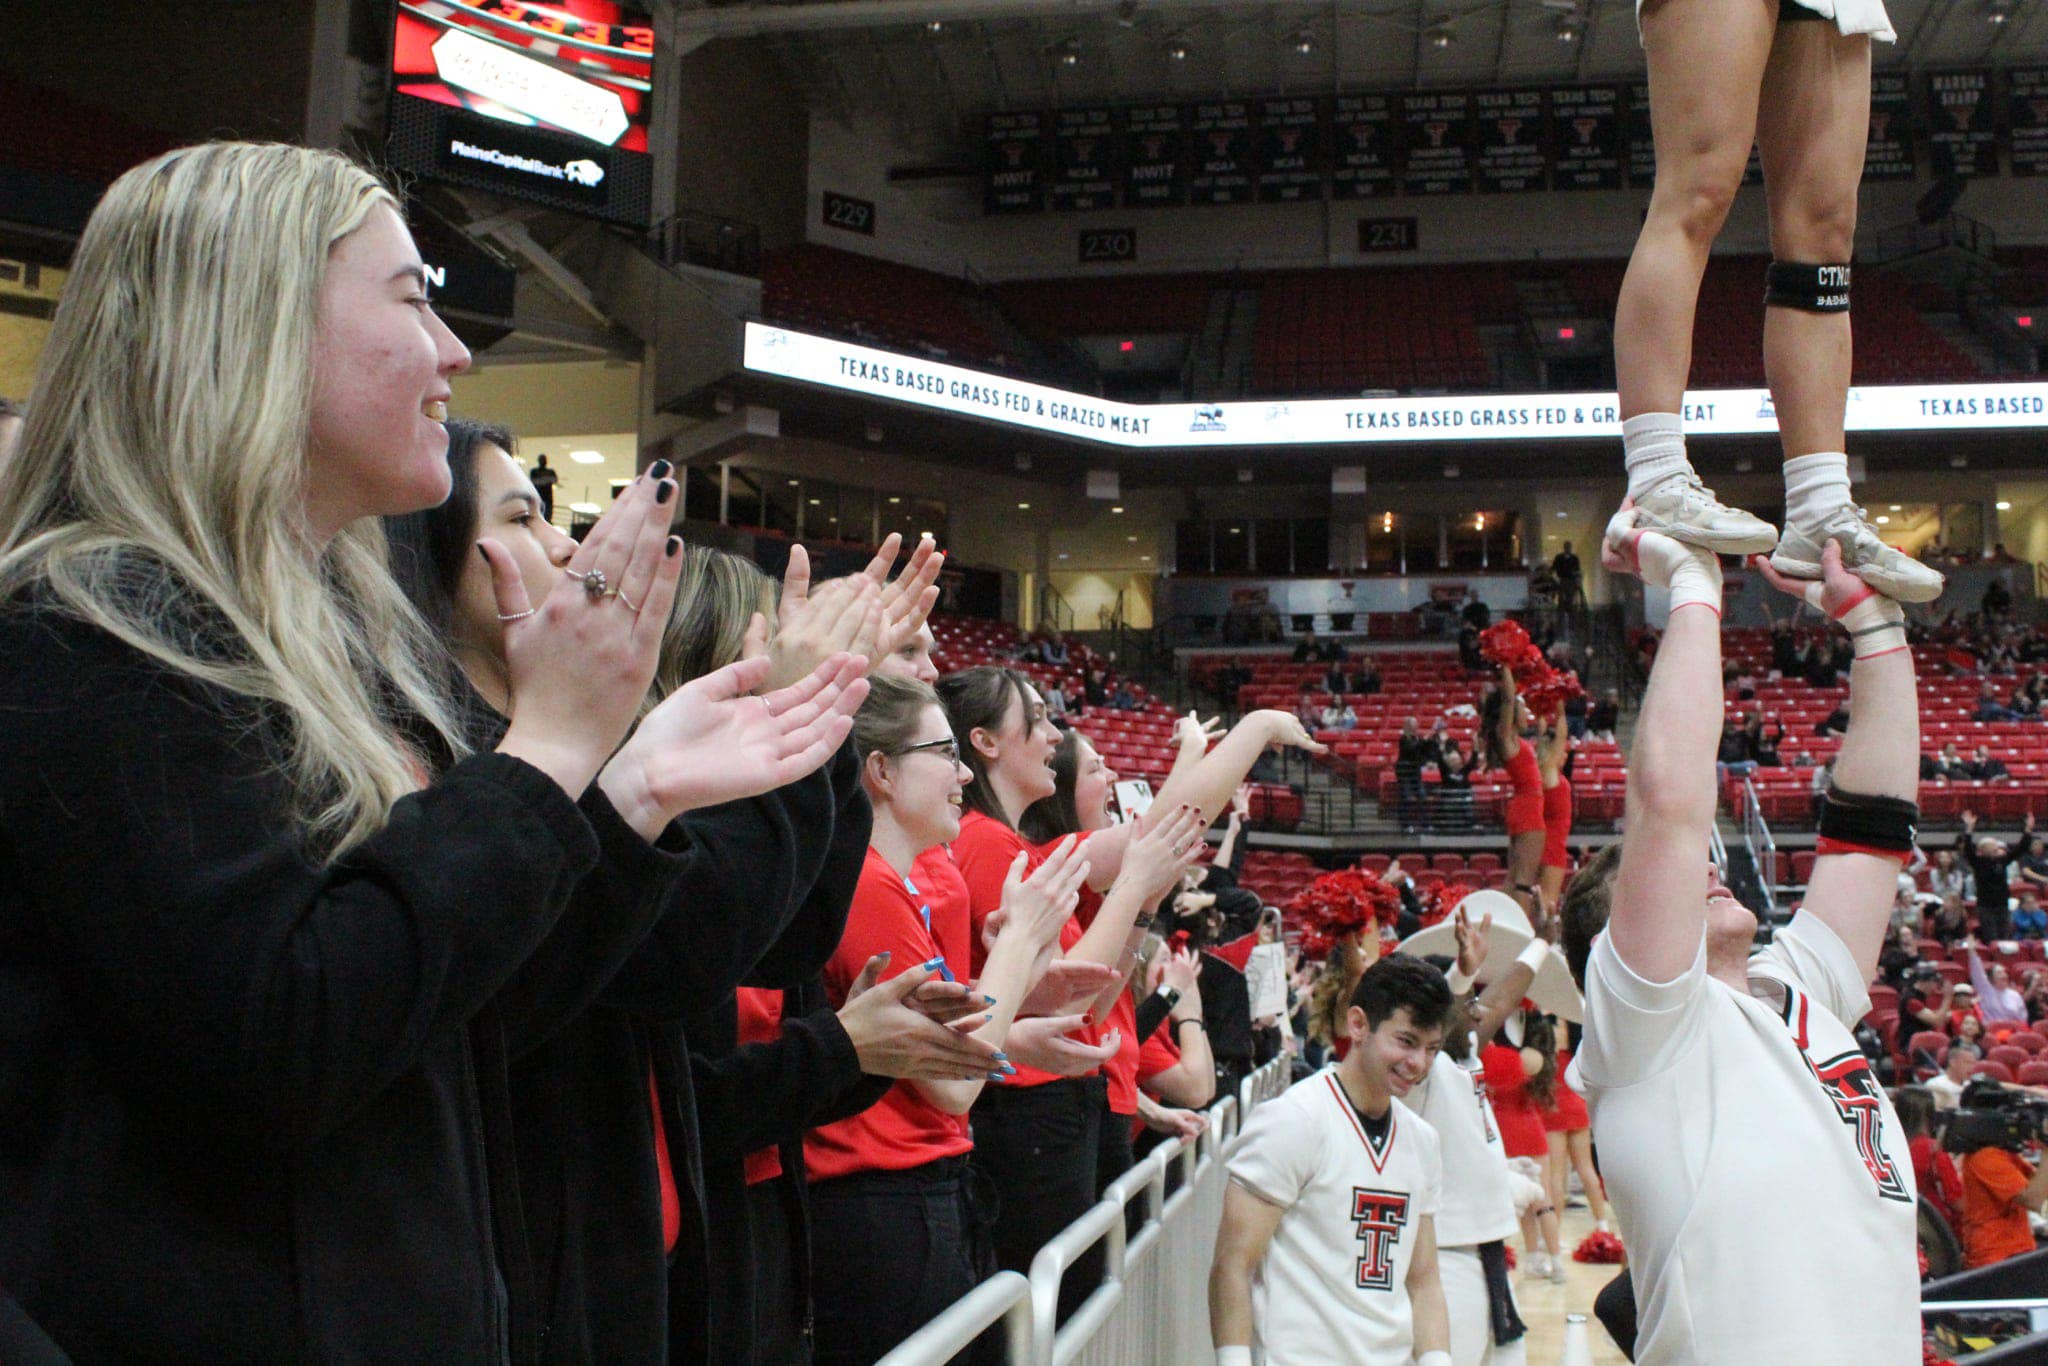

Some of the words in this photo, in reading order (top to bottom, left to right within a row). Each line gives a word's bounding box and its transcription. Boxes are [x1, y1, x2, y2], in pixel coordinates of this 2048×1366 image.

[830, 198, 869, 227] 229
[1085, 234, 1131, 257] 230
[1369, 223, 1408, 246] 231
[839, 357, 890, 383] TEXAS
[895, 369, 945, 394] BASED
[950, 381, 1000, 406] GRASS
[1005, 392, 1030, 412] FED
[1036, 399, 1044, 415] &
[1050, 402, 1105, 428] GRAZED
[1110, 415, 1151, 434] MEAT
[1919, 398, 1977, 415] TEXAS
[1985, 397, 2043, 414] BASED
[1345, 411, 1401, 428] TEXAS
[1407, 410, 1463, 427] BASED
[1470, 409, 1529, 425] GRASS
[1536, 408, 1566, 424] FED
[1573, 407, 1584, 423] &
